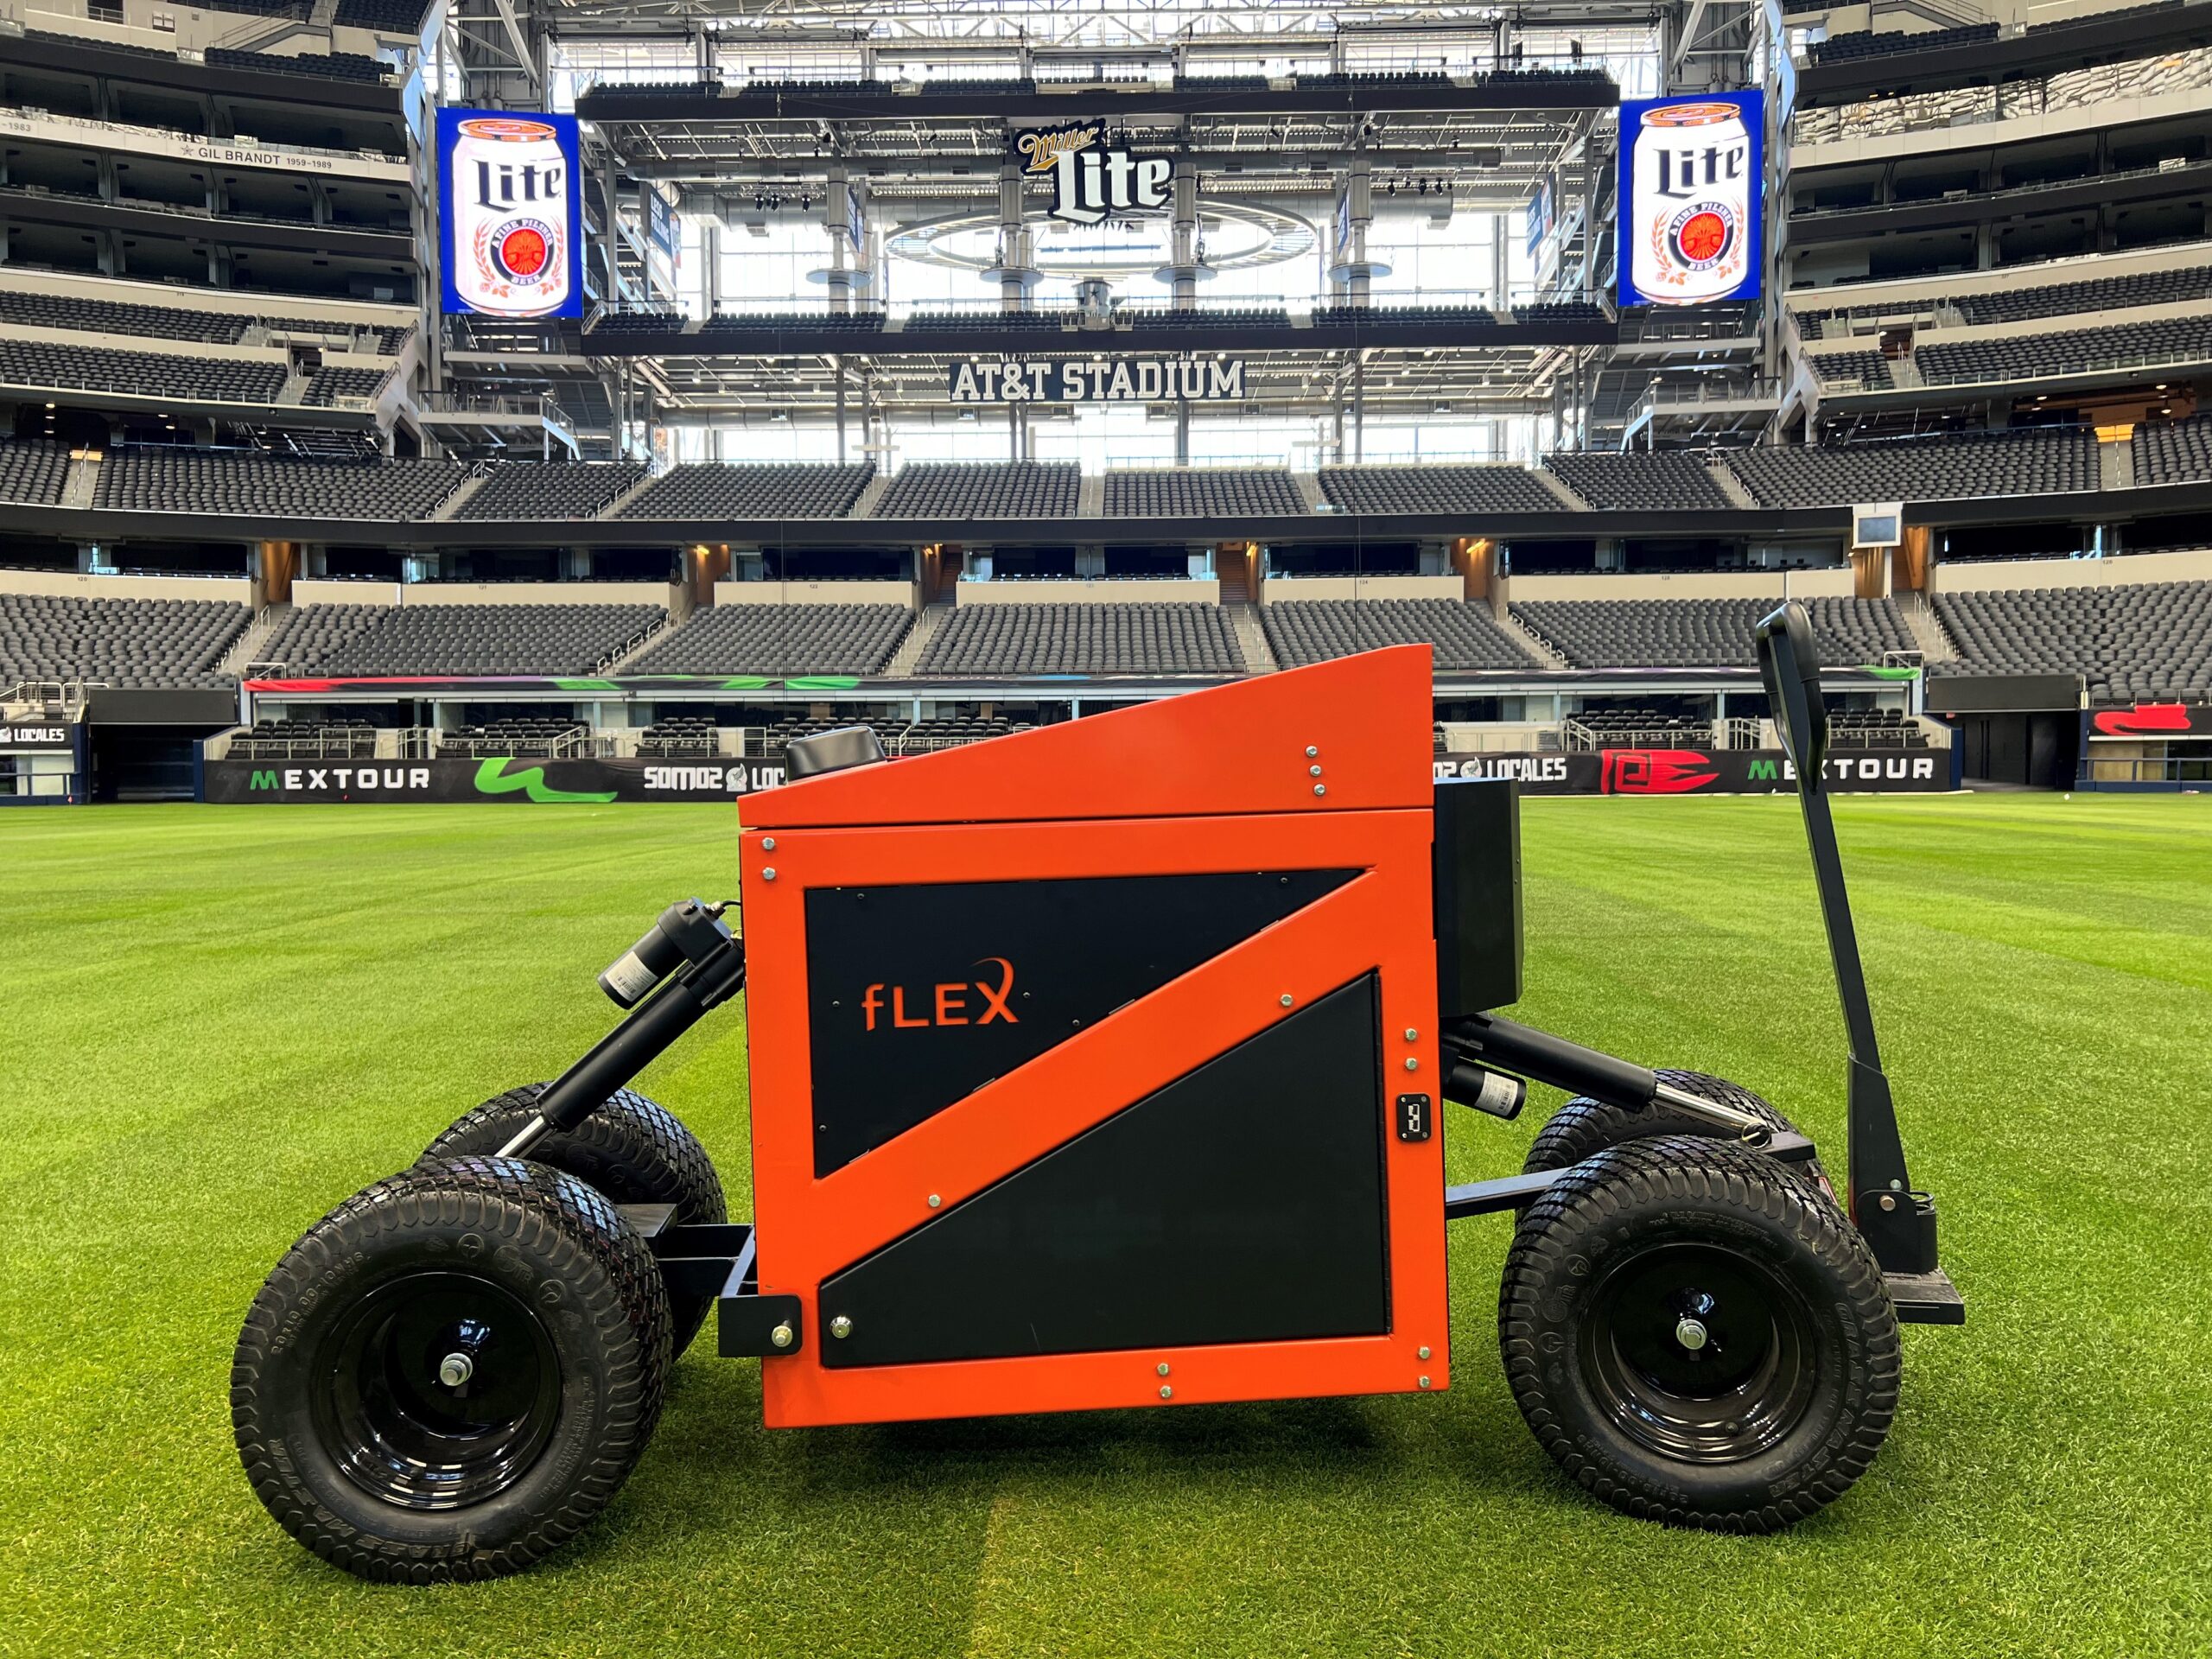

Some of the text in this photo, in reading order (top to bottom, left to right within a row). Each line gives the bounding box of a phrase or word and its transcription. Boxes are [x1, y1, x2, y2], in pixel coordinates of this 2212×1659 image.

[198, 147, 332, 169] GIL BRANDT 1959-1989
[1018, 127, 1100, 169] Miller
[1652, 145, 1744, 200] Lite
[472, 159, 562, 213] Lite
[1051, 150, 1171, 224] Lite
[1700, 202, 1733, 228] PILSNER
[521, 219, 554, 246] PILSNER
[1688, 257, 1719, 270] BEER
[511, 275, 542, 285] BEER
[951, 360, 1243, 401] AT&T STADIUM
[14, 728, 65, 742] LOCALES
[250, 768, 430, 790] MEXTOUR
